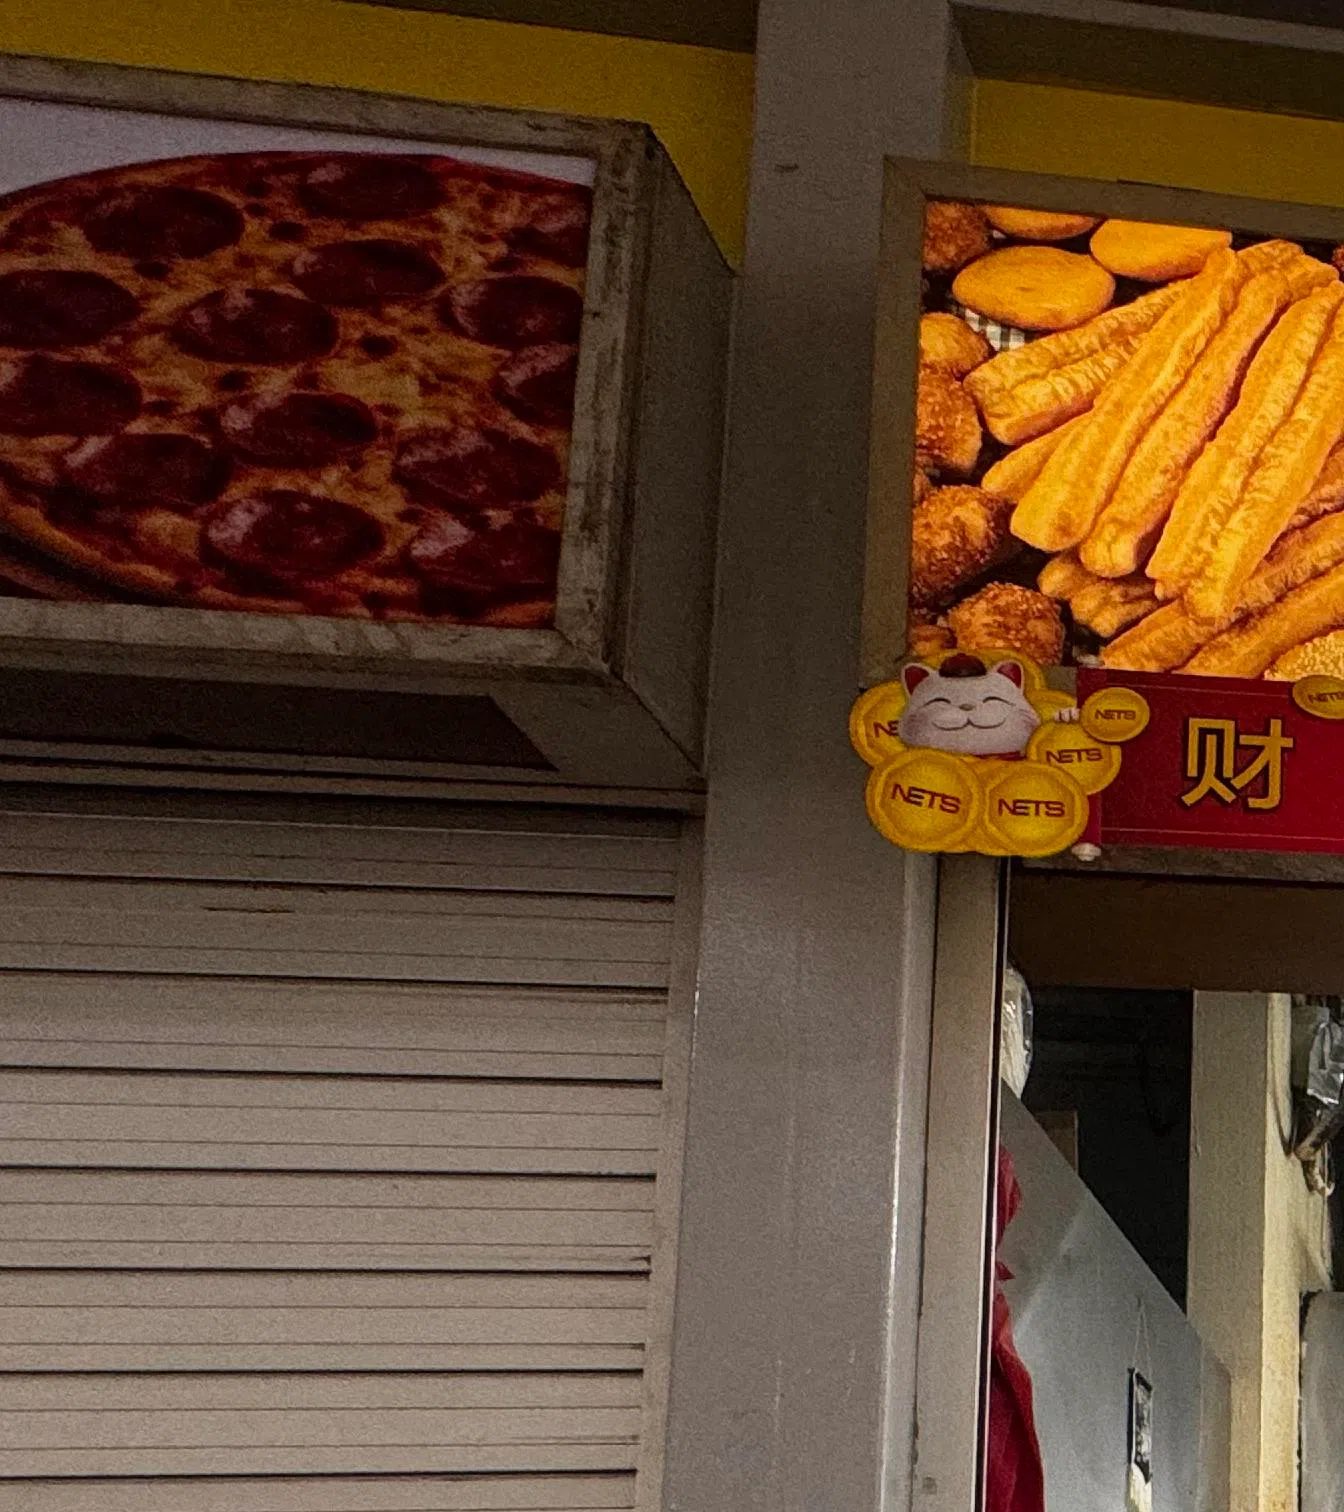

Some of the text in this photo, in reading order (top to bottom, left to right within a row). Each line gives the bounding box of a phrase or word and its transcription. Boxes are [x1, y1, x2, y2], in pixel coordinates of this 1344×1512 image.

[873, 719, 901, 738] NE
[1046, 747, 1105, 766] NETS
[891, 783, 961, 815] NETS
[999, 798, 1066, 819] NETS
